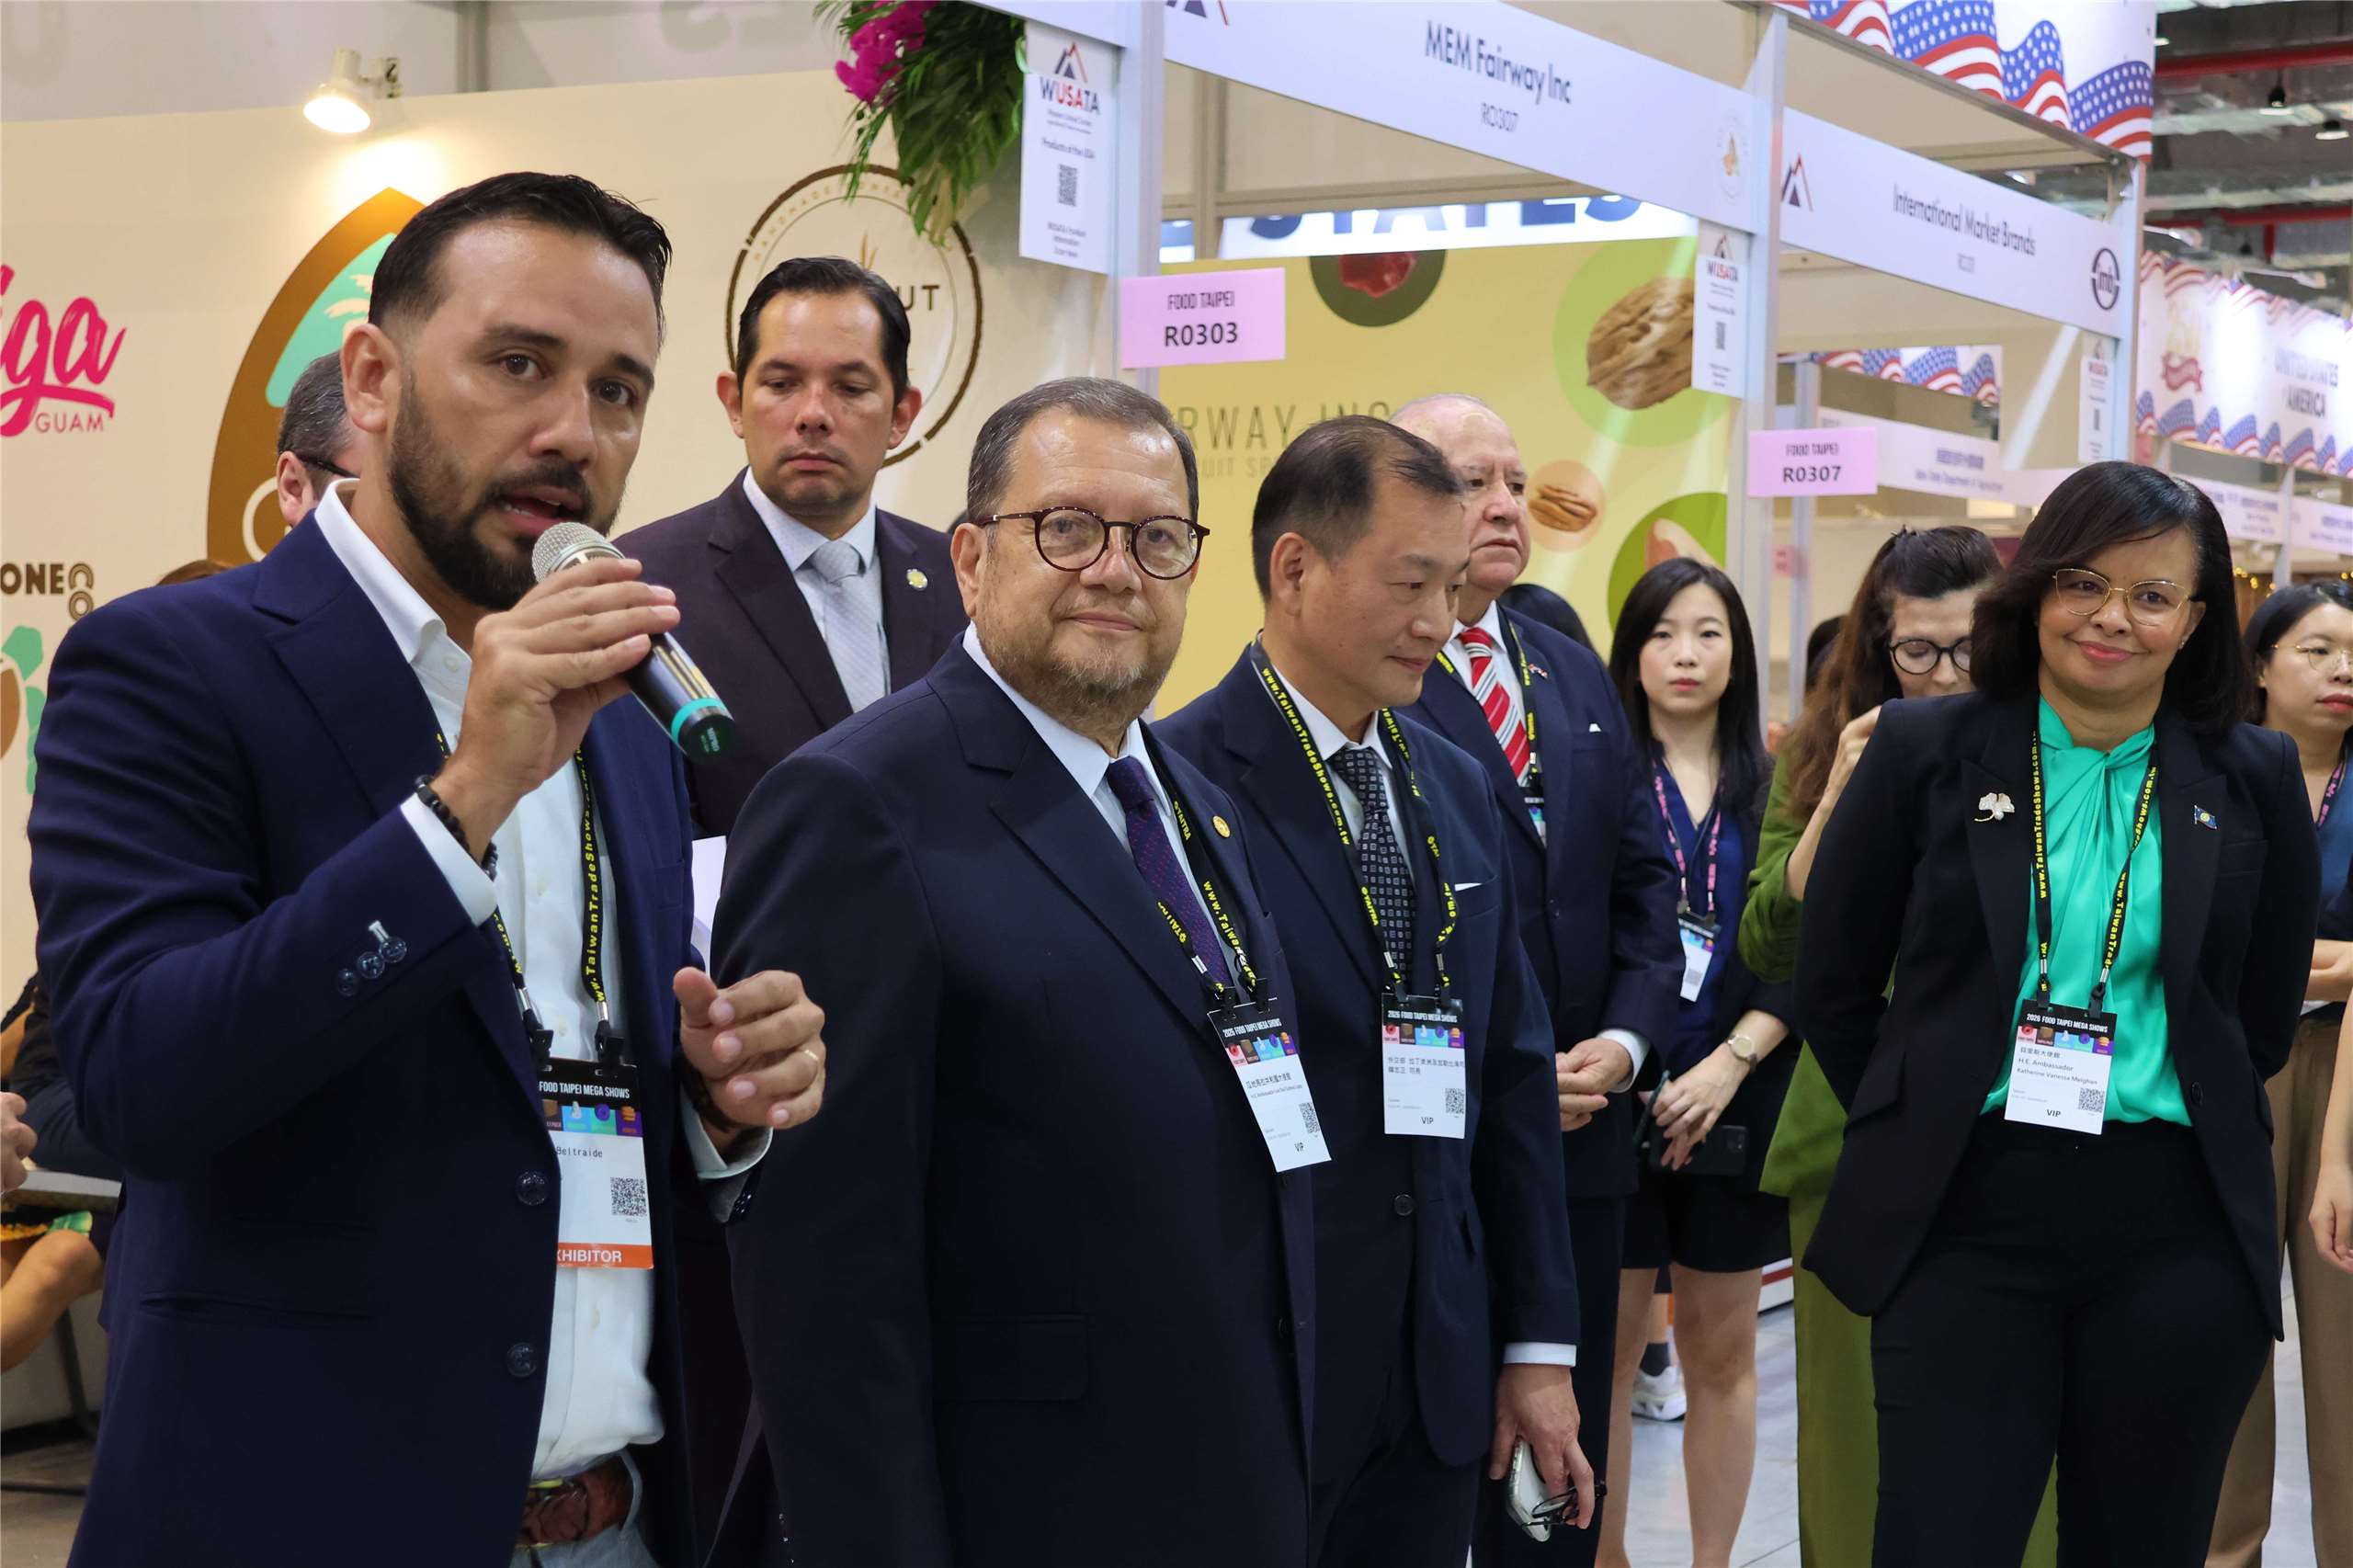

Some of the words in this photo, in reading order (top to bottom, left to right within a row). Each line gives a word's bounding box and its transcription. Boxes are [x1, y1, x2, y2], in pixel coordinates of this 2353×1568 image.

[1425, 19, 1472, 71] MEM
[1476, 38, 1545, 105] Fairway
[1548, 62, 1571, 104] Inc
[1040, 76, 1101, 116] WUSATA
[1893, 184, 1963, 233] International
[1965, 209, 2000, 244] Market
[2003, 221, 2035, 256] Brands
[1167, 292, 1197, 310] FOOD
[1200, 290, 1235, 308] TAIPEI
[1165, 323, 1238, 347] R0303
[35, 413, 104, 434] GUAM
[1786, 444, 1810, 457] FOOD
[1812, 442, 1839, 456] TAIPEI
[1782, 466, 1841, 483] R0307
[1262, 667, 1349, 846] www.TaiwanTradeShows.com.tw
[1233, 1026, 1246, 1036] FOOD
[1245, 1023, 1258, 1032] TAIPEI
[2041, 1016, 2056, 1025] FOOD
[2057, 1017, 2074, 1028] TAIPEI
[2074, 1021, 2088, 1030] MEGA
[2088, 1023, 2109, 1033] SHOWS
[2032, 1059, 2075, 1072] Ambassador
[539, 1081, 558, 1093] FOOD
[559, 1083, 582, 1095] TAIPEI
[583, 1085, 604, 1096] MEGA
[605, 1086, 630, 1099] SHOWS
[1421, 1117, 1434, 1125] VIP
[2046, 1109, 2062, 1118] VIP
[556, 1146, 603, 1158] Beltraide
